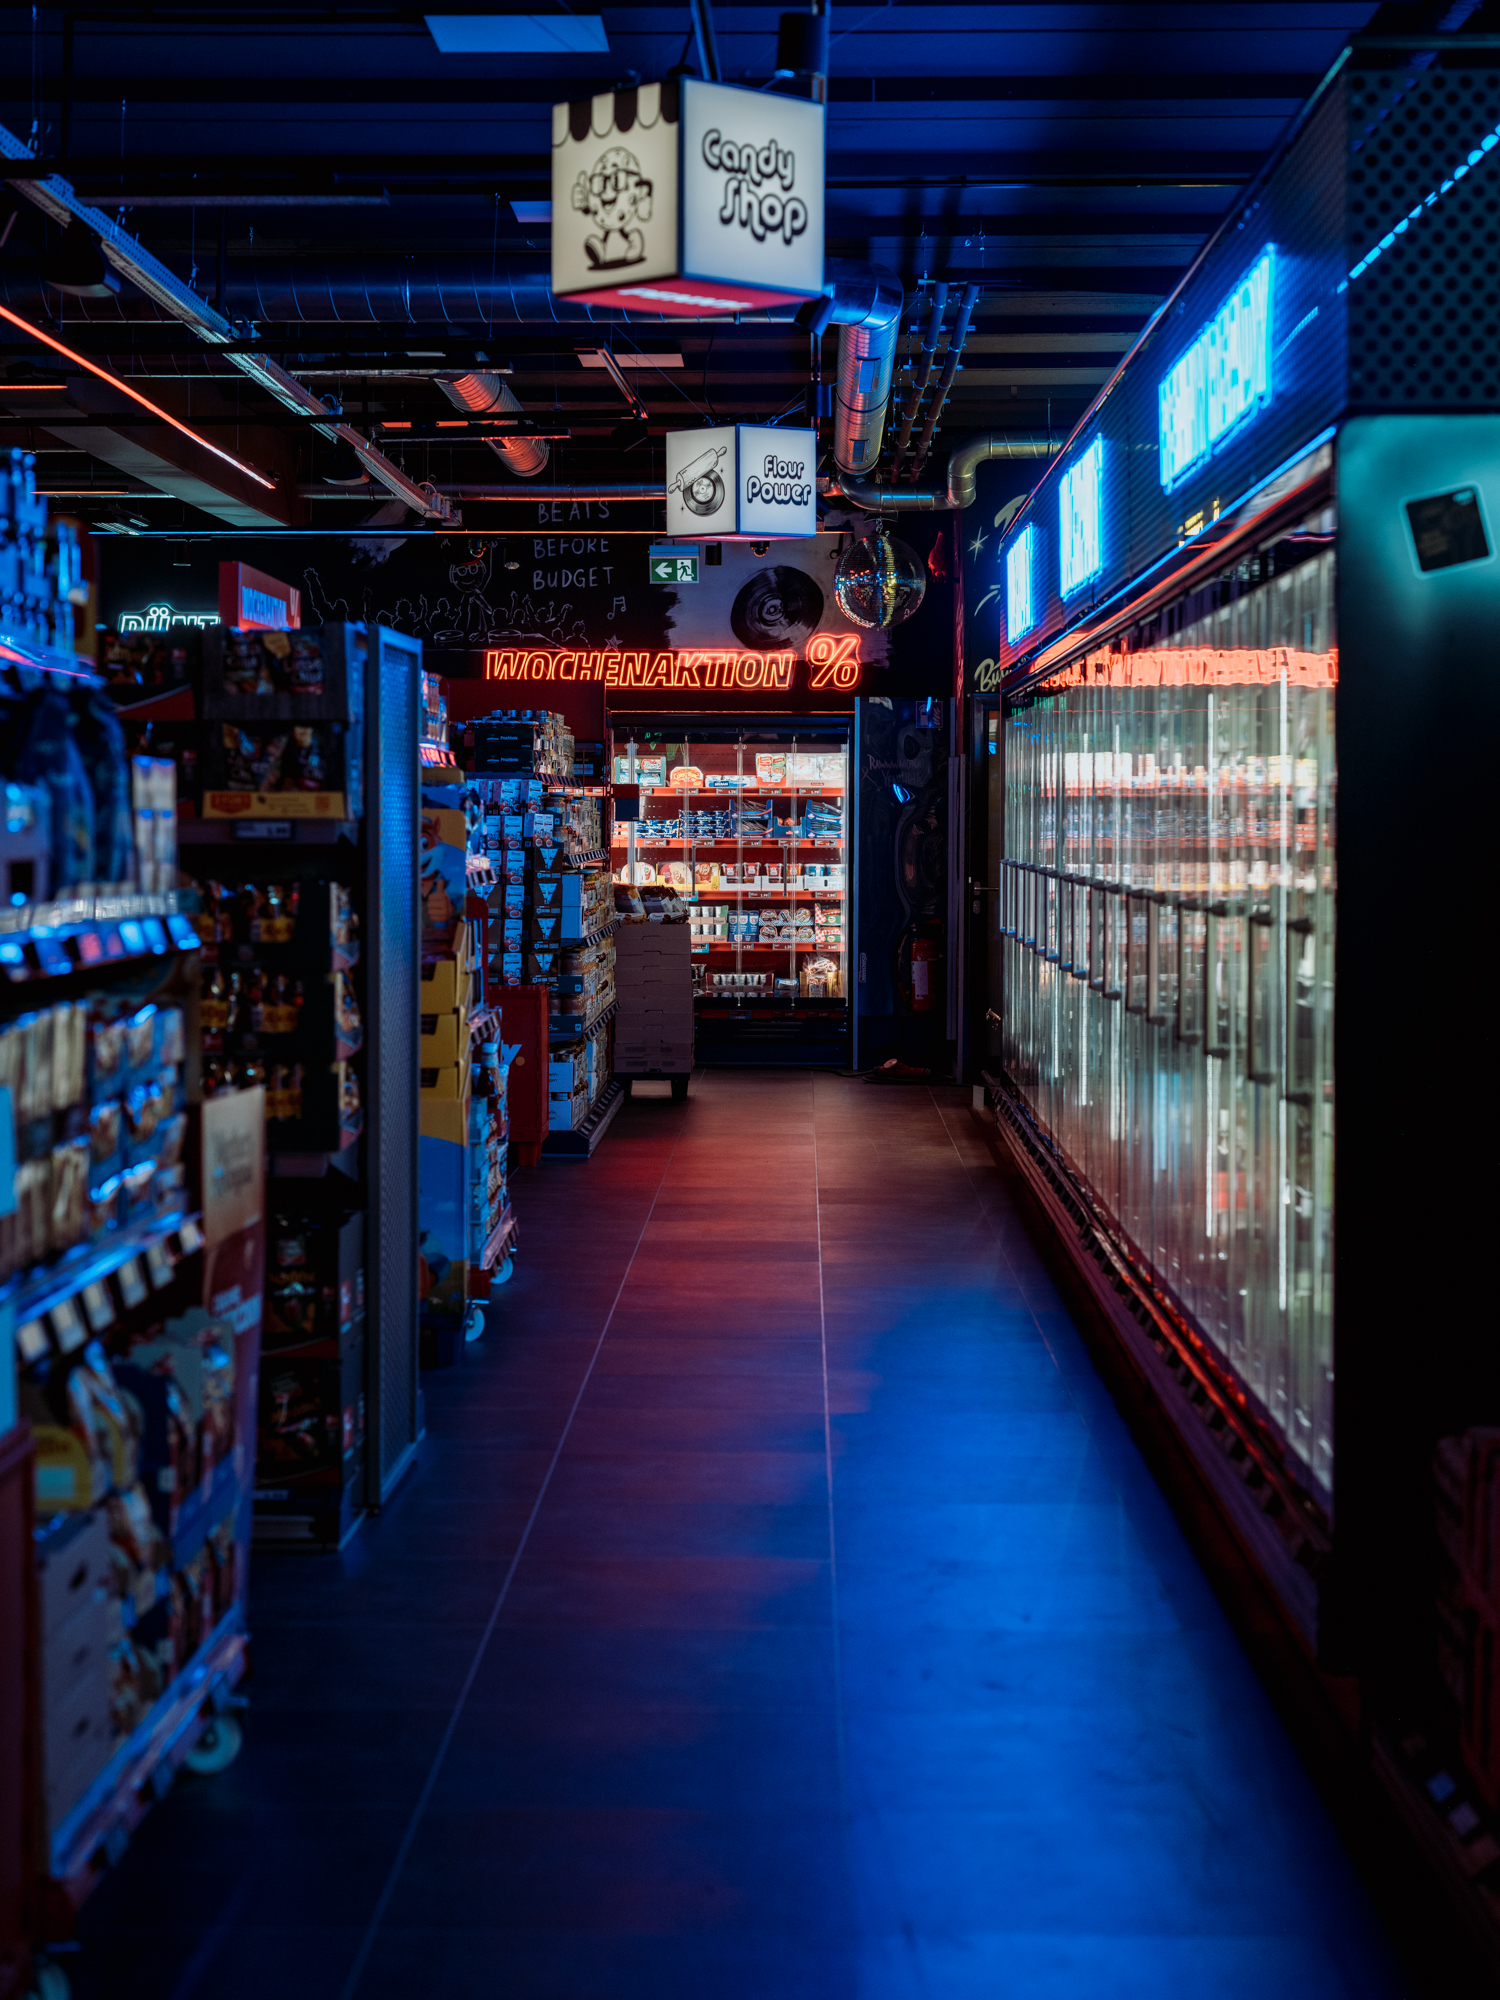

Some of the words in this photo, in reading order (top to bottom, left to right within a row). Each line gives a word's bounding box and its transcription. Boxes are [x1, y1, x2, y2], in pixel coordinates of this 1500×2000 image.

[702, 128, 795, 192] Candy
[719, 176, 808, 246] Shop
[764, 454, 805, 480] Flour
[747, 475, 812, 506] Power
[537, 500, 610, 525] BEATS
[533, 537, 610, 560] BEFORE
[532, 566, 615, 591] BUDGET
[485, 650, 795, 688] WOCHENAKTION
[809, 636, 861, 689] %
